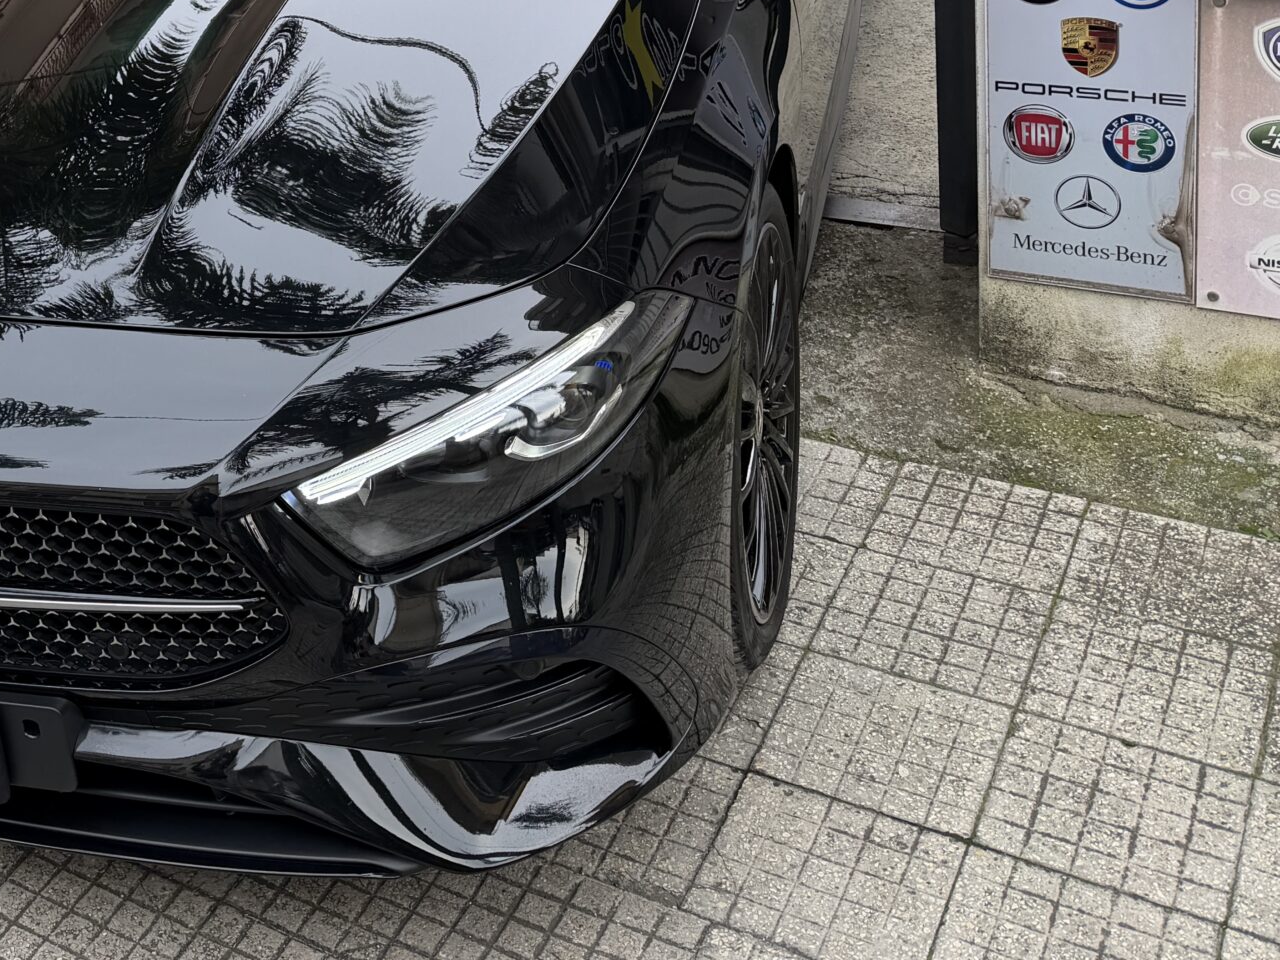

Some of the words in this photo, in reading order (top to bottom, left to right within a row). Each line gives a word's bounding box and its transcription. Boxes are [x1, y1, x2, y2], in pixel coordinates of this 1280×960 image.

[1062, 17, 1117, 30] PORSCHE
[995, 80, 1187, 107] PORSCHE
[1021, 121, 1060, 148] FIAT
[1105, 116, 1128, 141] ALFA
[1134, 114, 1174, 148] ROMEO
[1012, 232, 1168, 268] Mercedes-Benz
